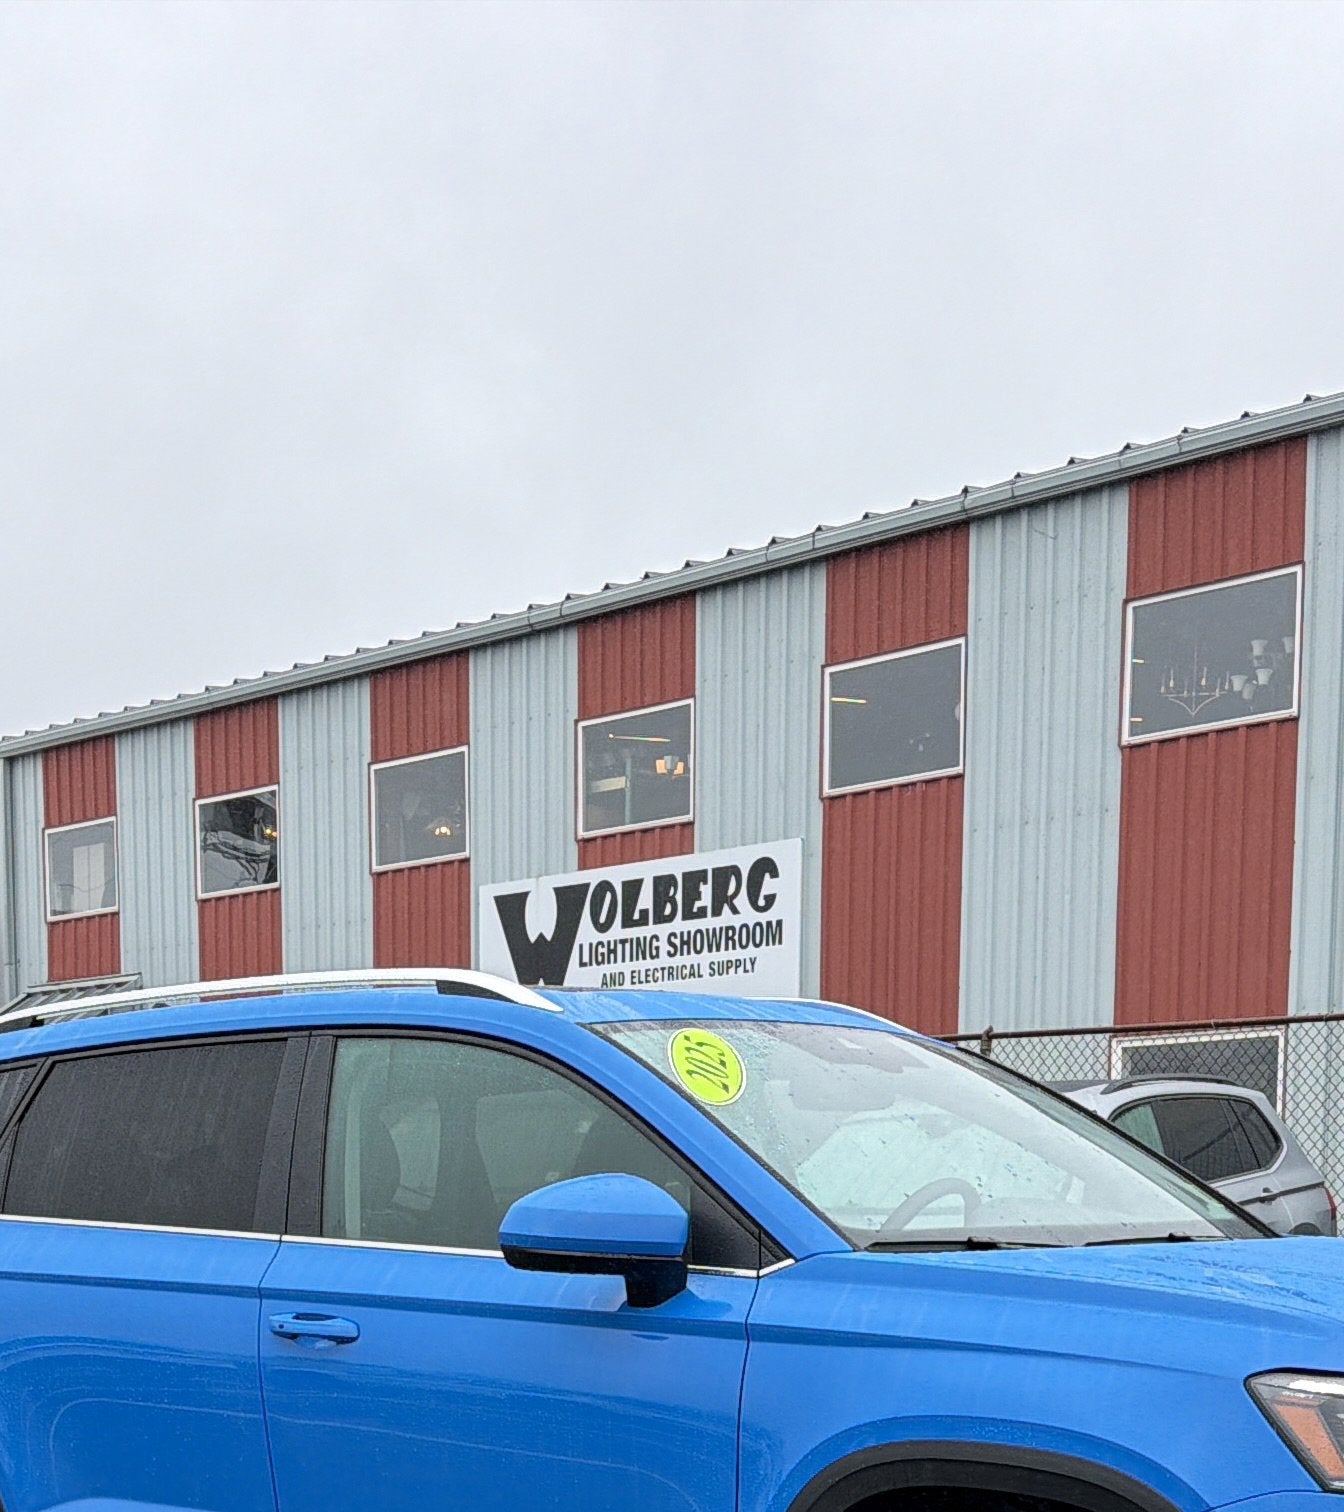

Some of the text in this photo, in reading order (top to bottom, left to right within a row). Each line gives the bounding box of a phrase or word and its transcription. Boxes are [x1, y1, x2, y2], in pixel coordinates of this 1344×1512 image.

[493, 855, 780, 986] WOLBERG
[578, 918, 784, 968] LIGHTING SHOWROOM
[601, 956, 758, 989] AND ELECTRICAL SUPPLY
[683, 1034, 730, 1094] 2025
